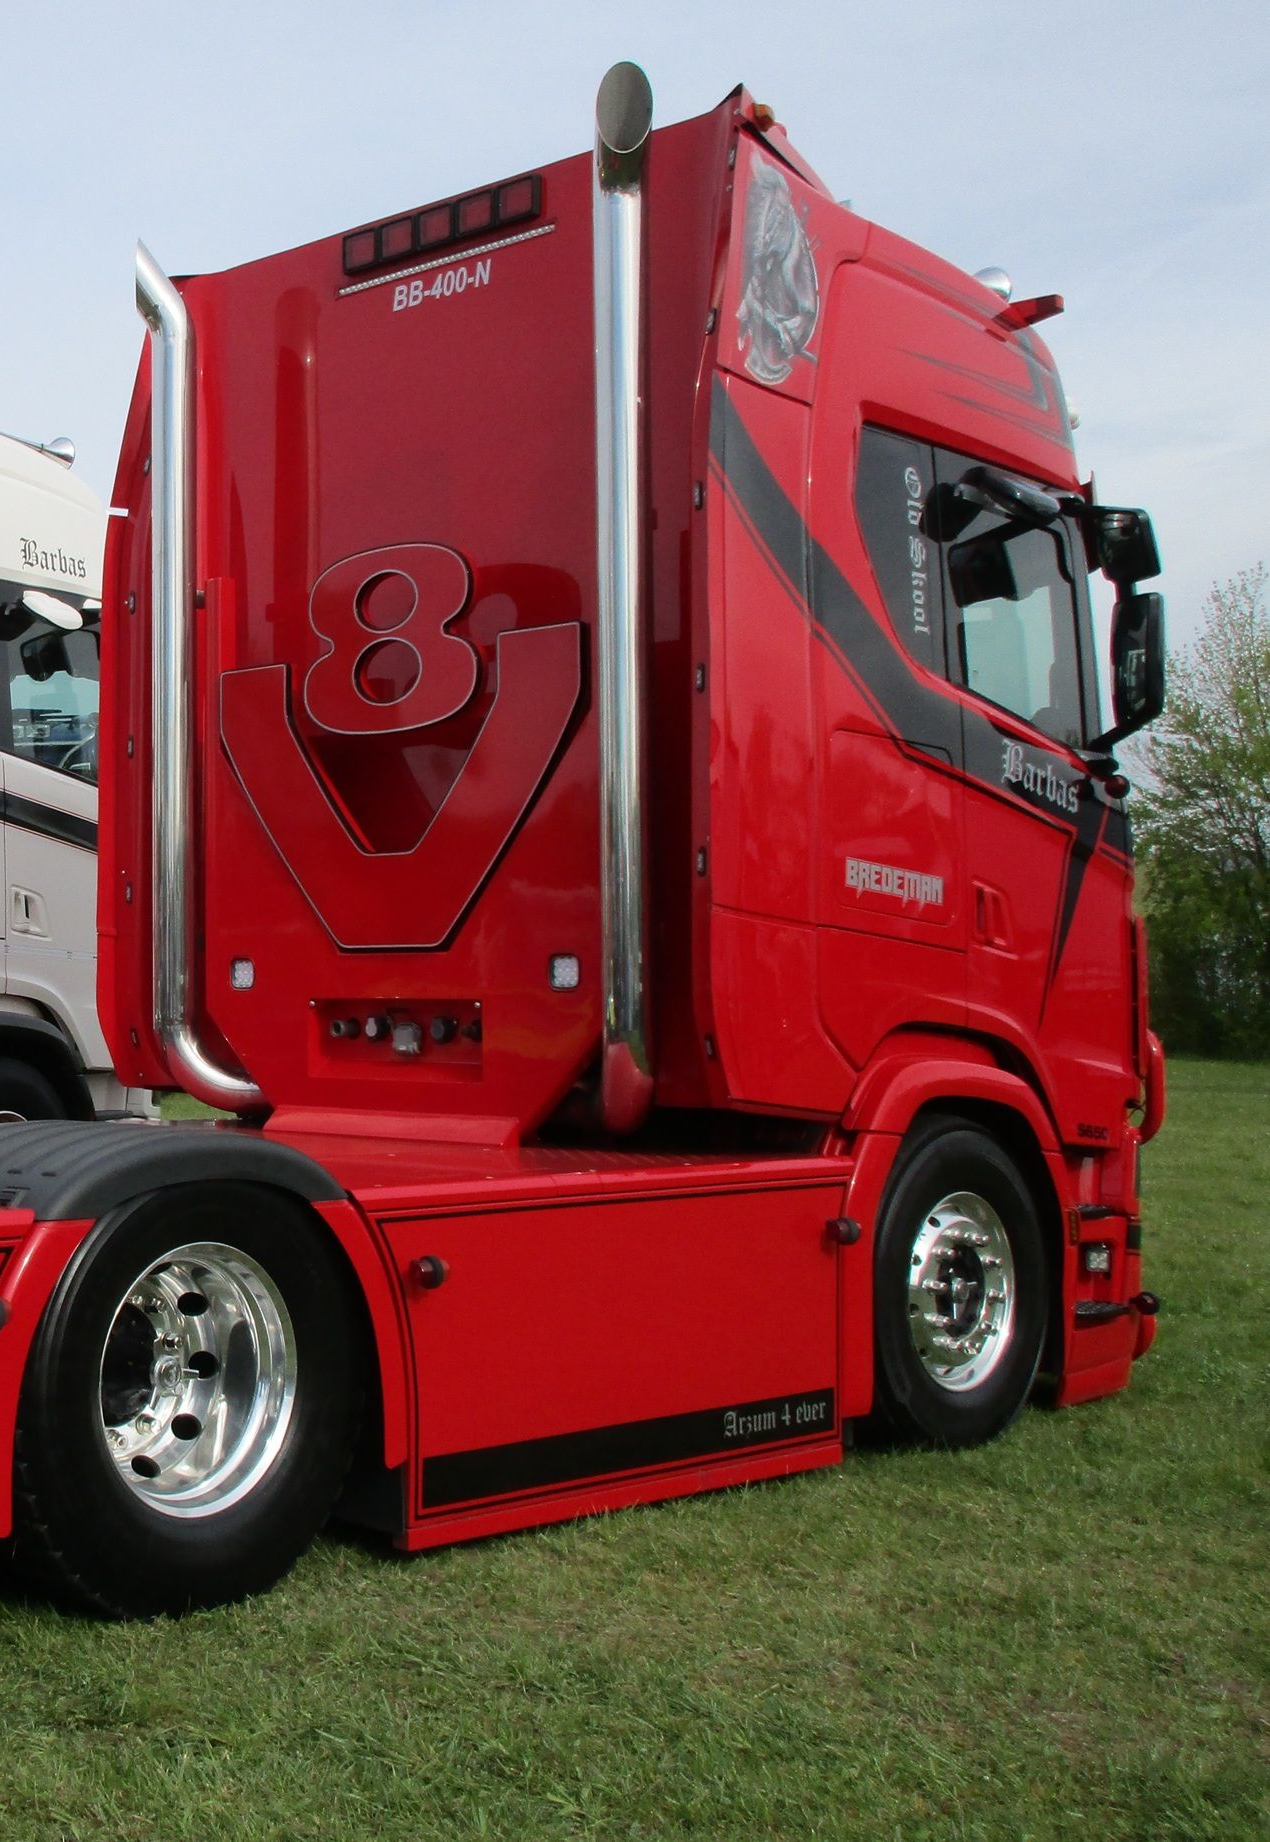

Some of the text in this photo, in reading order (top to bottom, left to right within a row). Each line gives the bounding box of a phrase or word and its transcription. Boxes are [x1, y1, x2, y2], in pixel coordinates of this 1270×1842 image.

[393, 259, 492, 312] BB-400-N
[19, 537, 87, 578] Barbas
[904, 466, 930, 635] Old Skool
[1001, 738, 1079, 813] Barbas
[845, 857, 944, 907] BREDEMAN
[781, 1403, 791, 1426] 4
[796, 1401, 827, 1423] ever
